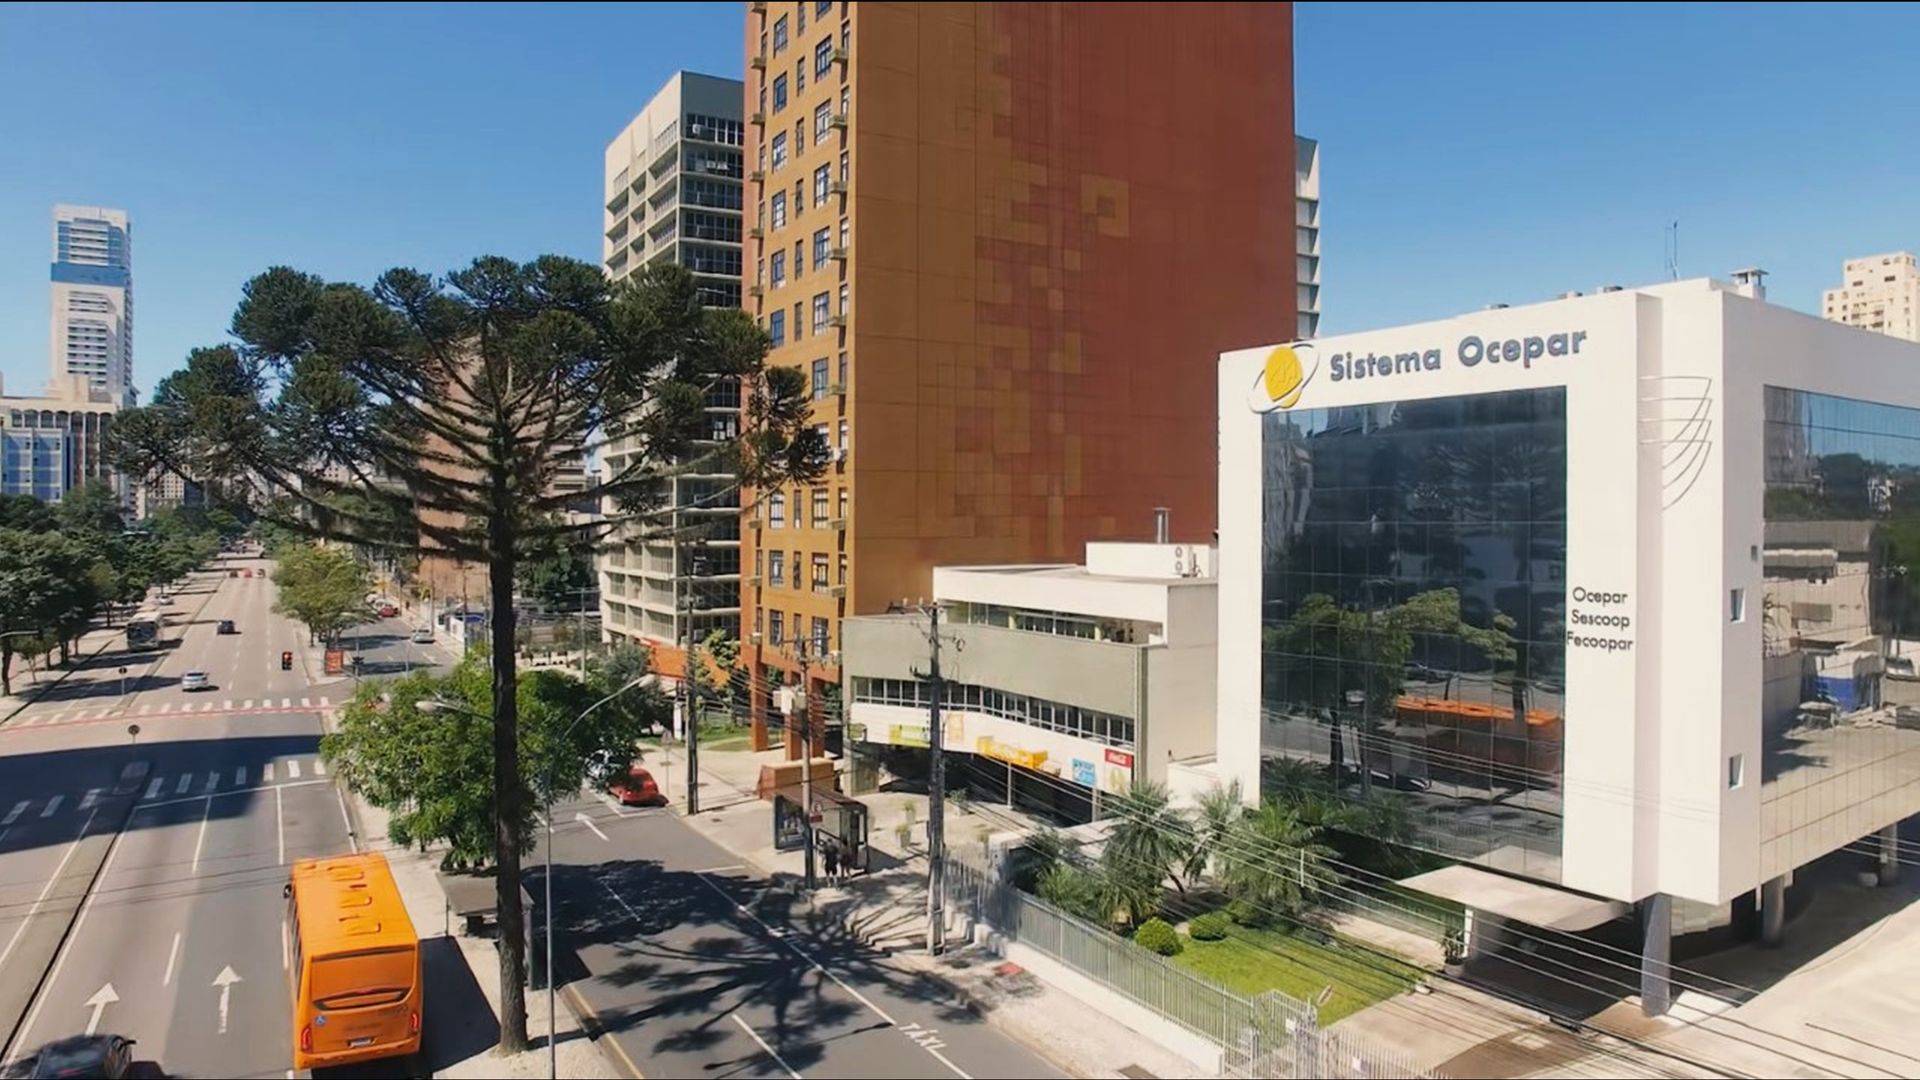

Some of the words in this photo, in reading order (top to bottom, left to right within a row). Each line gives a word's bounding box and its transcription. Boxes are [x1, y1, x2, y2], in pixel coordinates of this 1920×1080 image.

[1330, 348, 1441, 382] Sistema
[1458, 330, 1587, 369] Ocepar
[1572, 586, 1628, 607] Ocepar
[1571, 608, 1630, 632] Sescoop
[1566, 630, 1634, 654] Fecoopar
